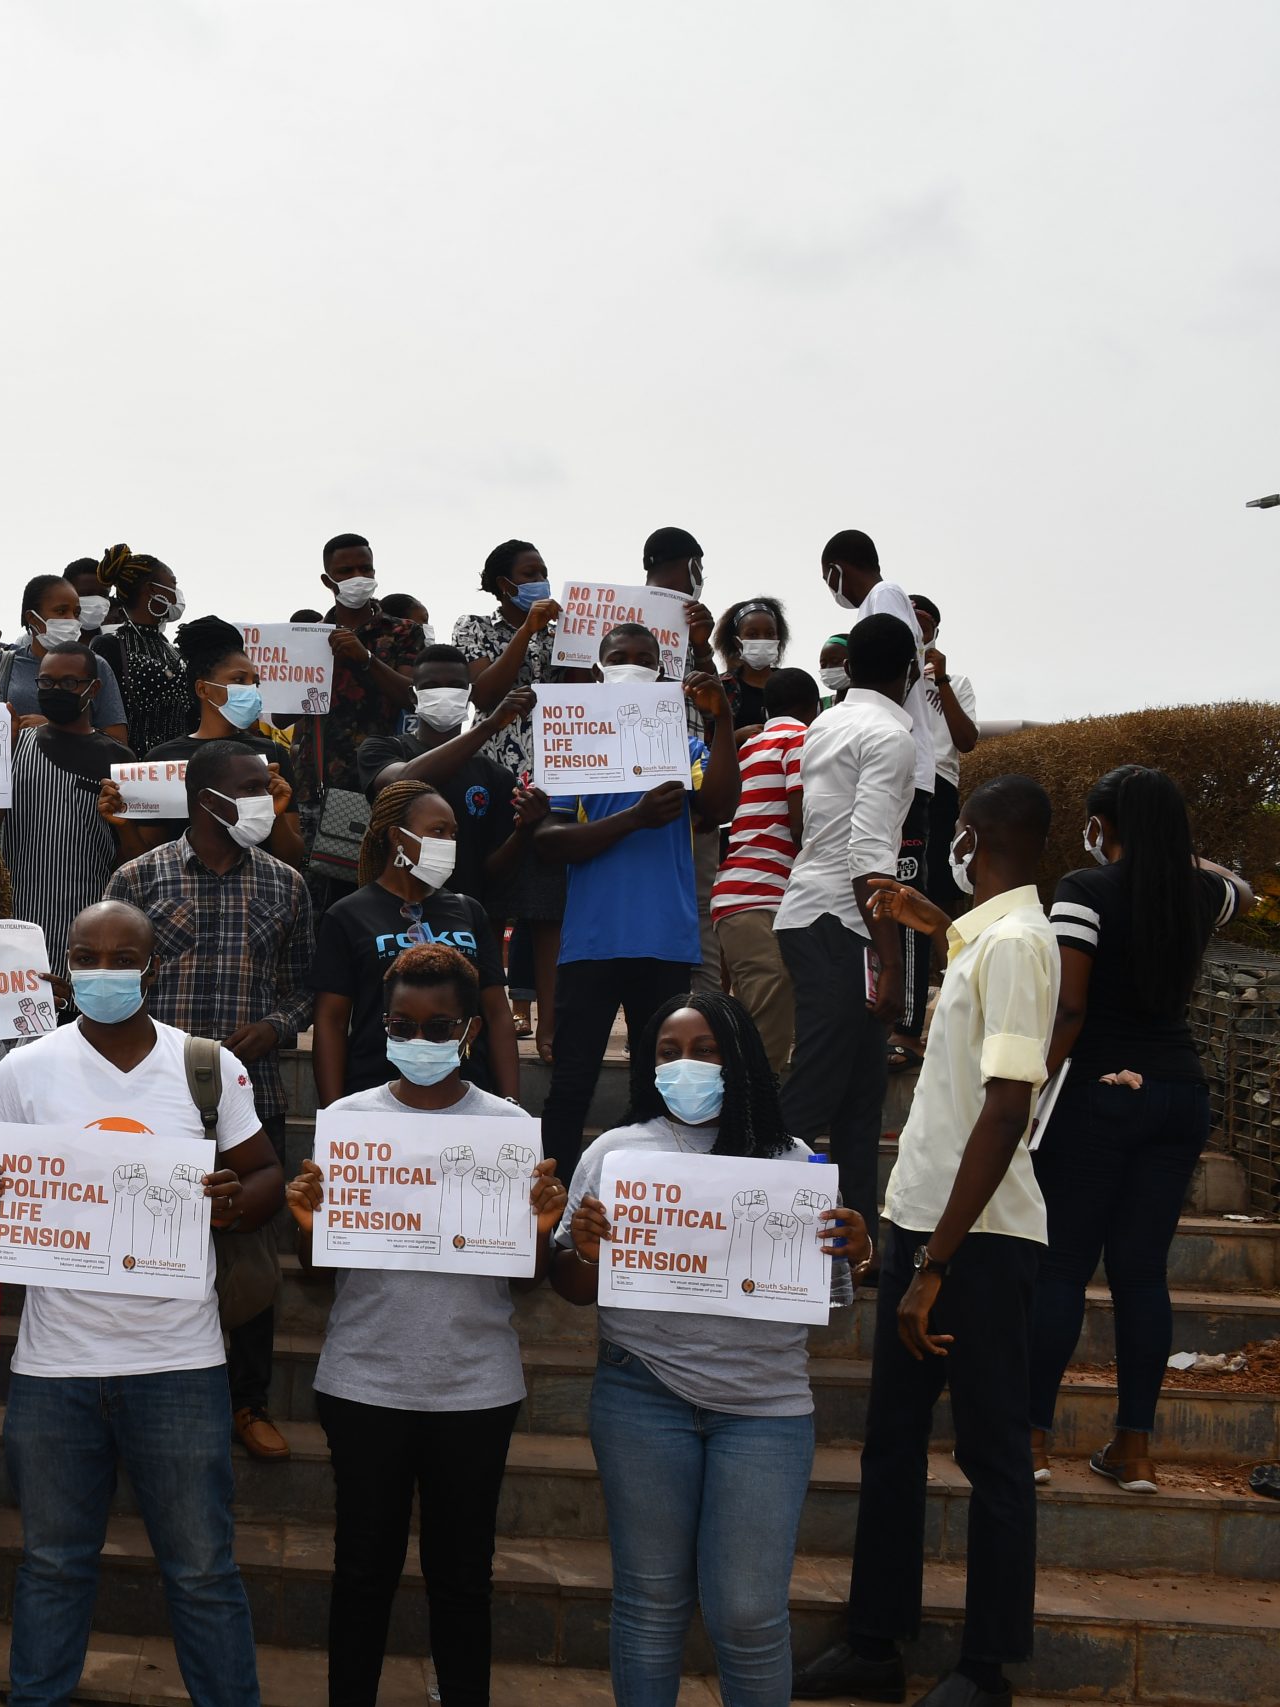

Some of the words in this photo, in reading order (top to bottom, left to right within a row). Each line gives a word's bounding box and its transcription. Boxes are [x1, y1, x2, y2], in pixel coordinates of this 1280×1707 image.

[569, 586, 591, 601] NO
[597, 589, 615, 603] TO
[566, 603, 645, 623] POLITICAL
[563, 617, 597, 636] LIFE
[243, 628, 260, 644] TO
[245, 646, 288, 663] ITICAL
[543, 706, 564, 718] NO
[566, 705, 585, 718] TO
[544, 722, 616, 735] POLITICAL
[544, 738, 572, 751] LIFE
[544, 754, 608, 768] PENSION
[120, 765, 159, 781] LIFE
[330, 1142, 359, 1160] NO
[364, 1143, 391, 1161] TO
[2, 1154, 32, 1174] NO
[38, 1157, 65, 1177] TO
[329, 1165, 436, 1186] POLITICAL
[2, 1178, 109, 1204] POLITICAL
[329, 1189, 371, 1206] LIFE
[616, 1180, 646, 1200] NO
[652, 1183, 681, 1203] TO
[328, 1210, 421, 1231] PENSION
[614, 1204, 727, 1230] POLITICAL
[611, 1226, 657, 1246] LIFE
[159, 1260, 186, 1268] Saharan
[611, 1249, 707, 1273] PENSION
[756, 1282, 777, 1290] South
[780, 1284, 808, 1292] Saharan
